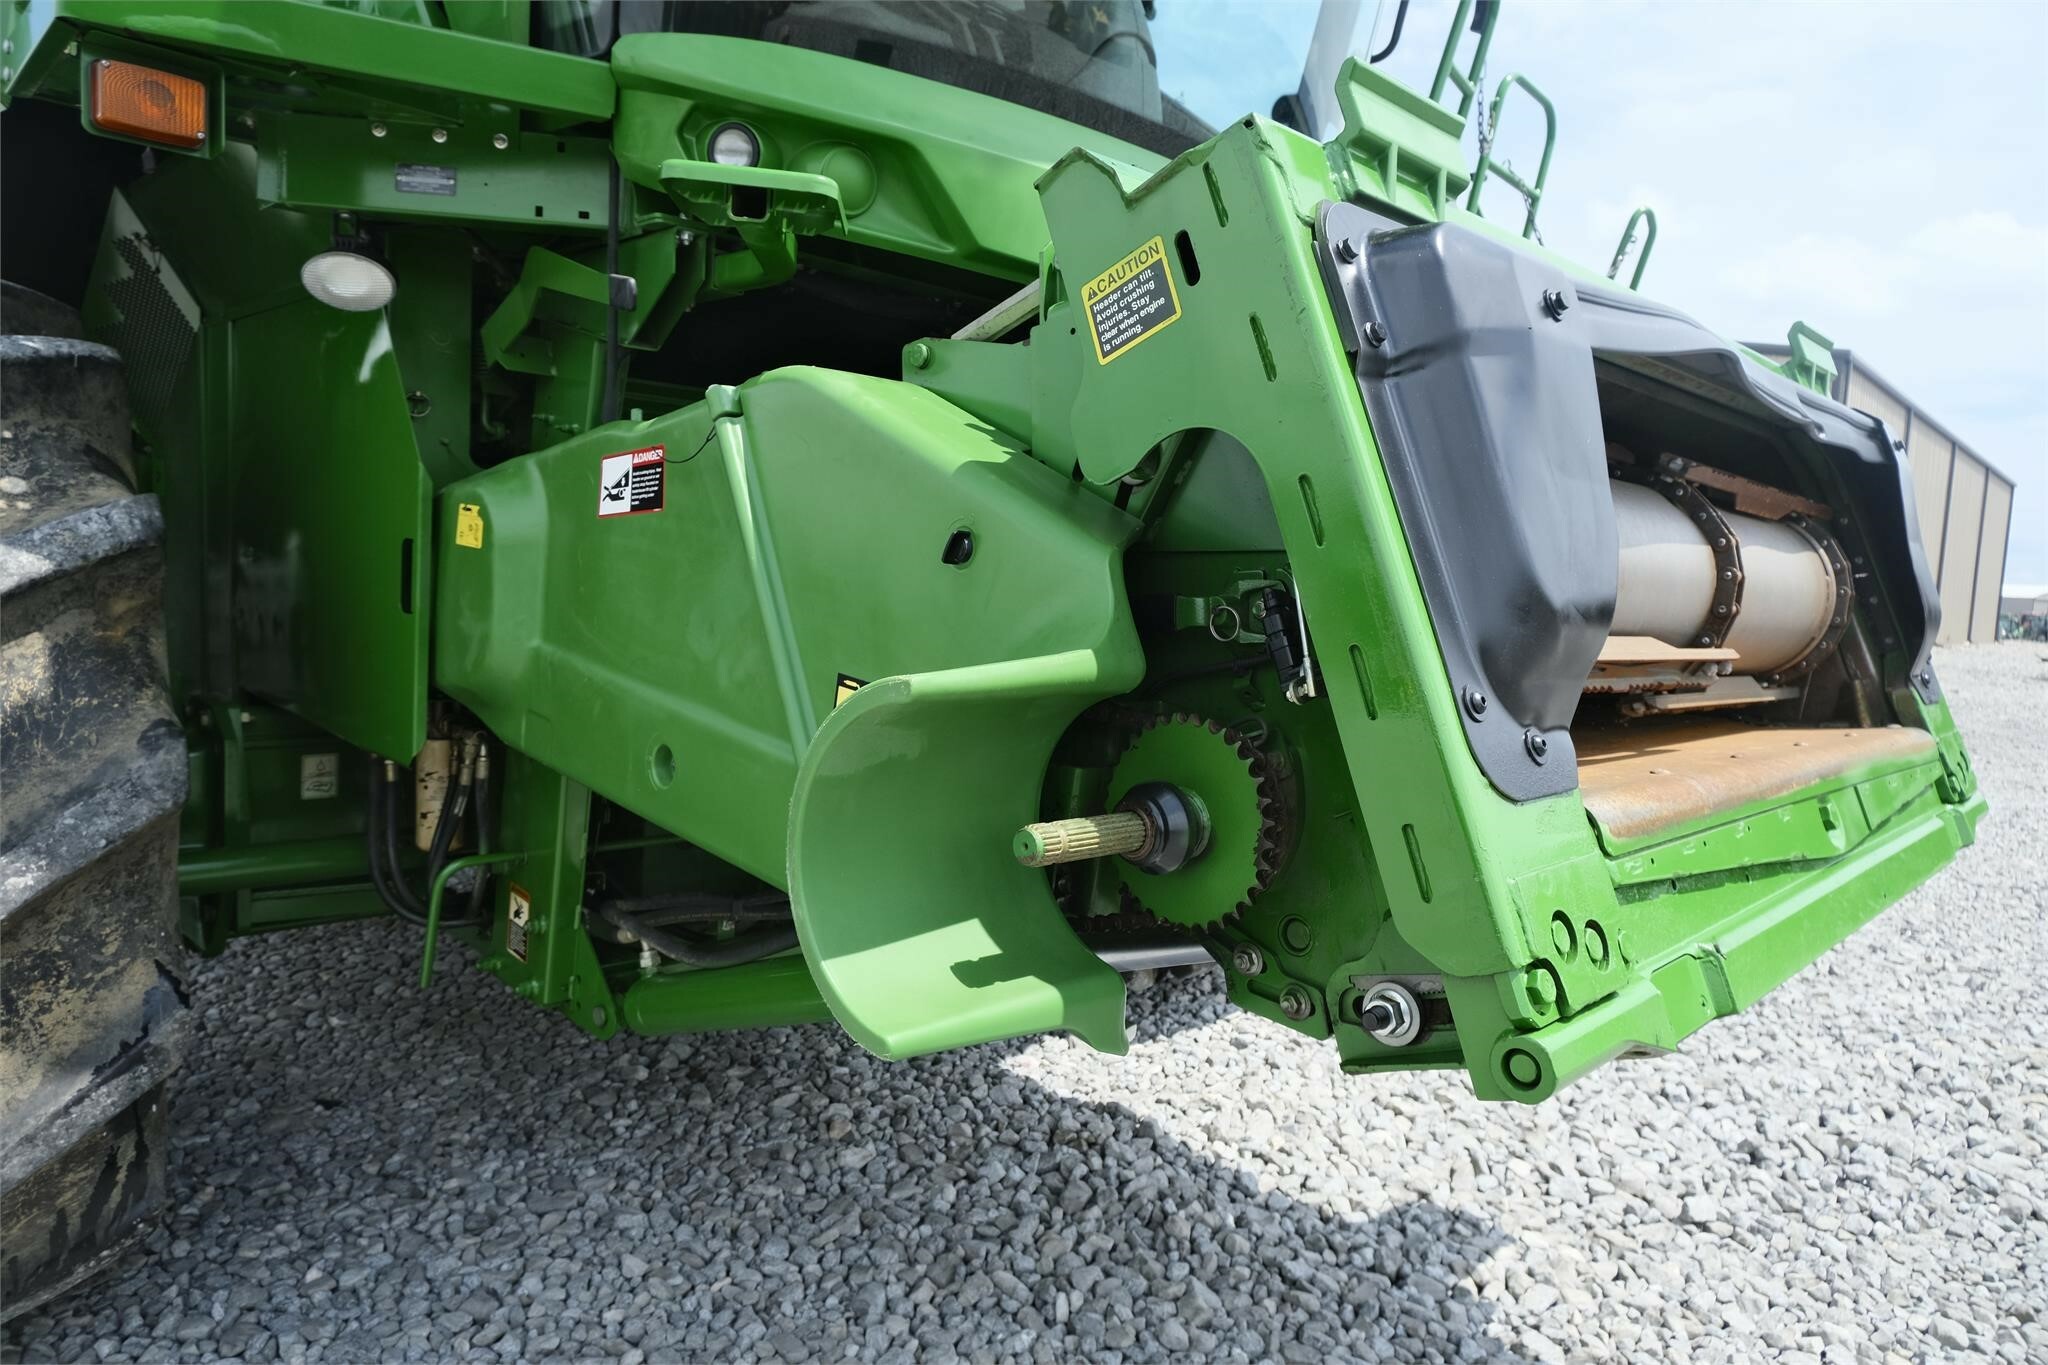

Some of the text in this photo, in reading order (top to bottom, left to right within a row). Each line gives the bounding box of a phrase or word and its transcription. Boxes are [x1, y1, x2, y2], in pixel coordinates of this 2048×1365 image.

[1097, 242, 1160, 293] CAUTION
[1093, 269, 1155, 313] Header can tilt.
[1096, 280, 1155, 323] Avoid crushing
[1098, 294, 1151, 333] injuries. Stay
[1101, 297, 1165, 343] clear when engine
[1111, 324, 1144, 347] running.
[639, 449, 663, 463] DANGER
